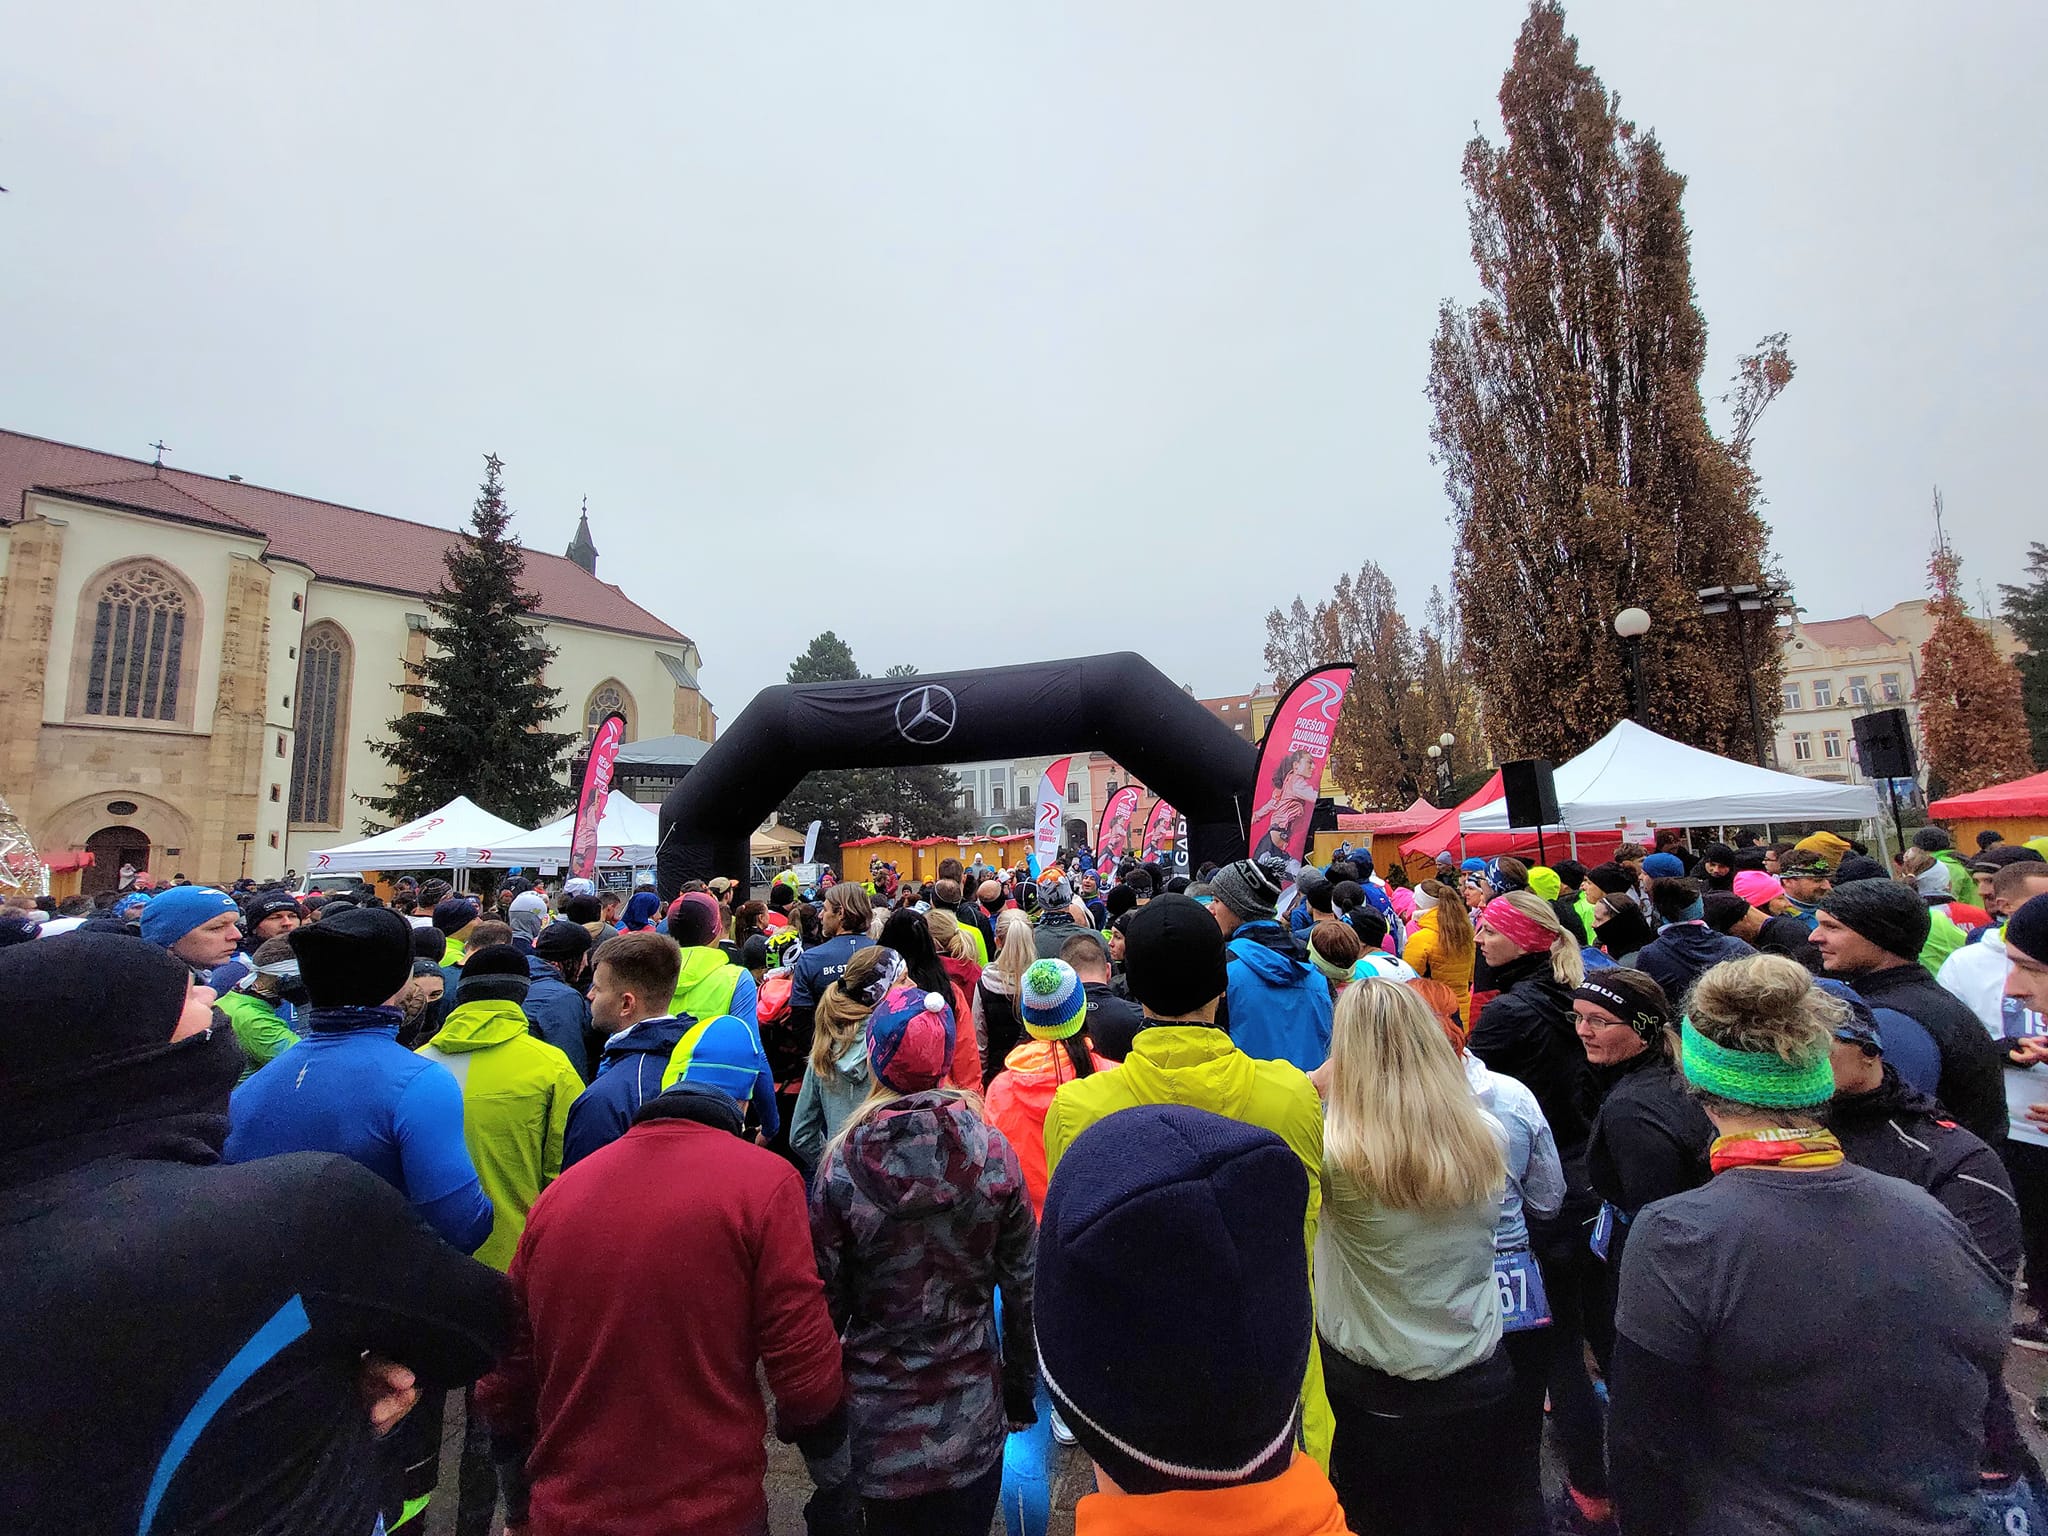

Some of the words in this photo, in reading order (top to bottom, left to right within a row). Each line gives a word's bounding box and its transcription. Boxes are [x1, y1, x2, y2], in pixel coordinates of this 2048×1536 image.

[1294, 717, 1328, 733] PREŠOV
[1291, 728, 1330, 746] RUNNING
[822, 965, 836, 976] BK
[837, 964, 849, 974] ST
